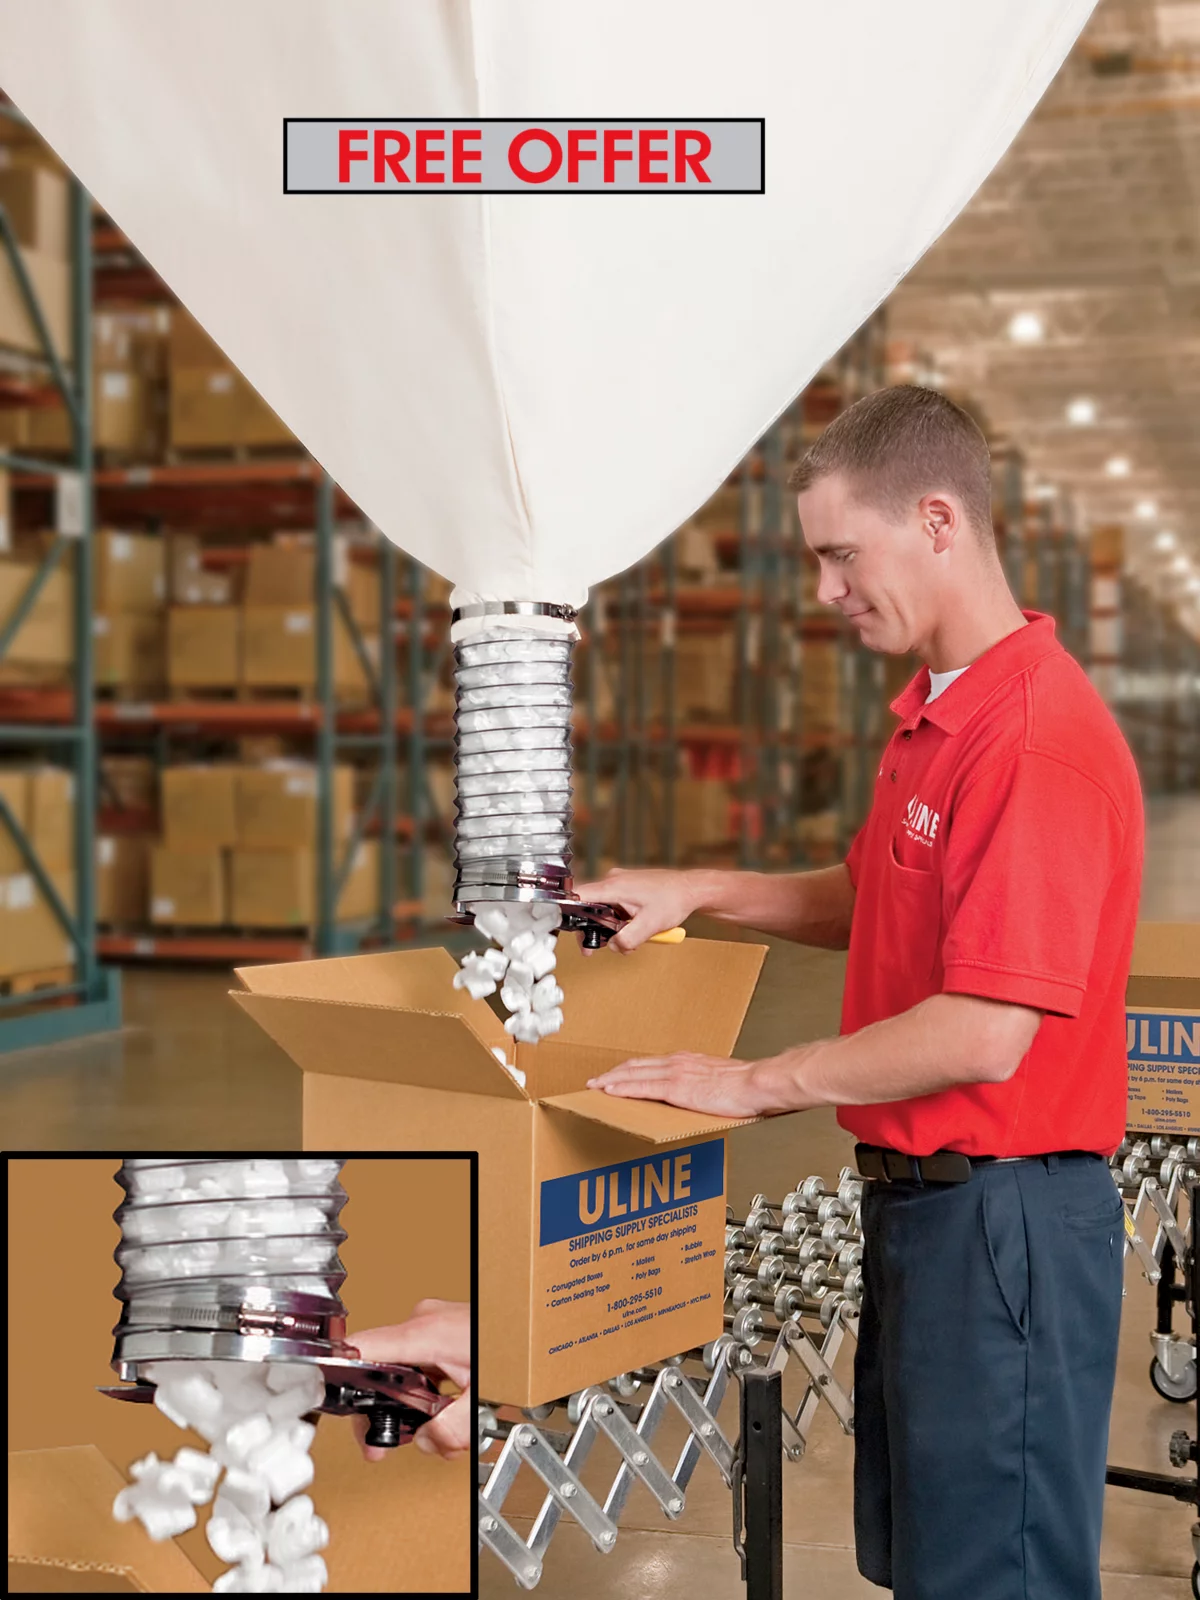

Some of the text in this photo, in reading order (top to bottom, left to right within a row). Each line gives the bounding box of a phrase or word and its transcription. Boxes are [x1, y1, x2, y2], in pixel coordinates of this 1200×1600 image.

[1126, 1018, 1200, 1057] LIN
[1147, 1064, 1175, 1073] SUPPLY
[578, 1153, 692, 1225] ULINE
[568, 1205, 698, 1252] SHIPPING SUPPLY SPECIALISTS
[569, 1224, 697, 1268] Order by 6 p.m. for same day shipping
[551, 1275, 586, 1293] Corrugated
[551, 1283, 611, 1308] Carton Sealing Tape
[607, 1286, 663, 1312] 1-800-295-5510
[548, 1341, 574, 1355] CHICAGO
